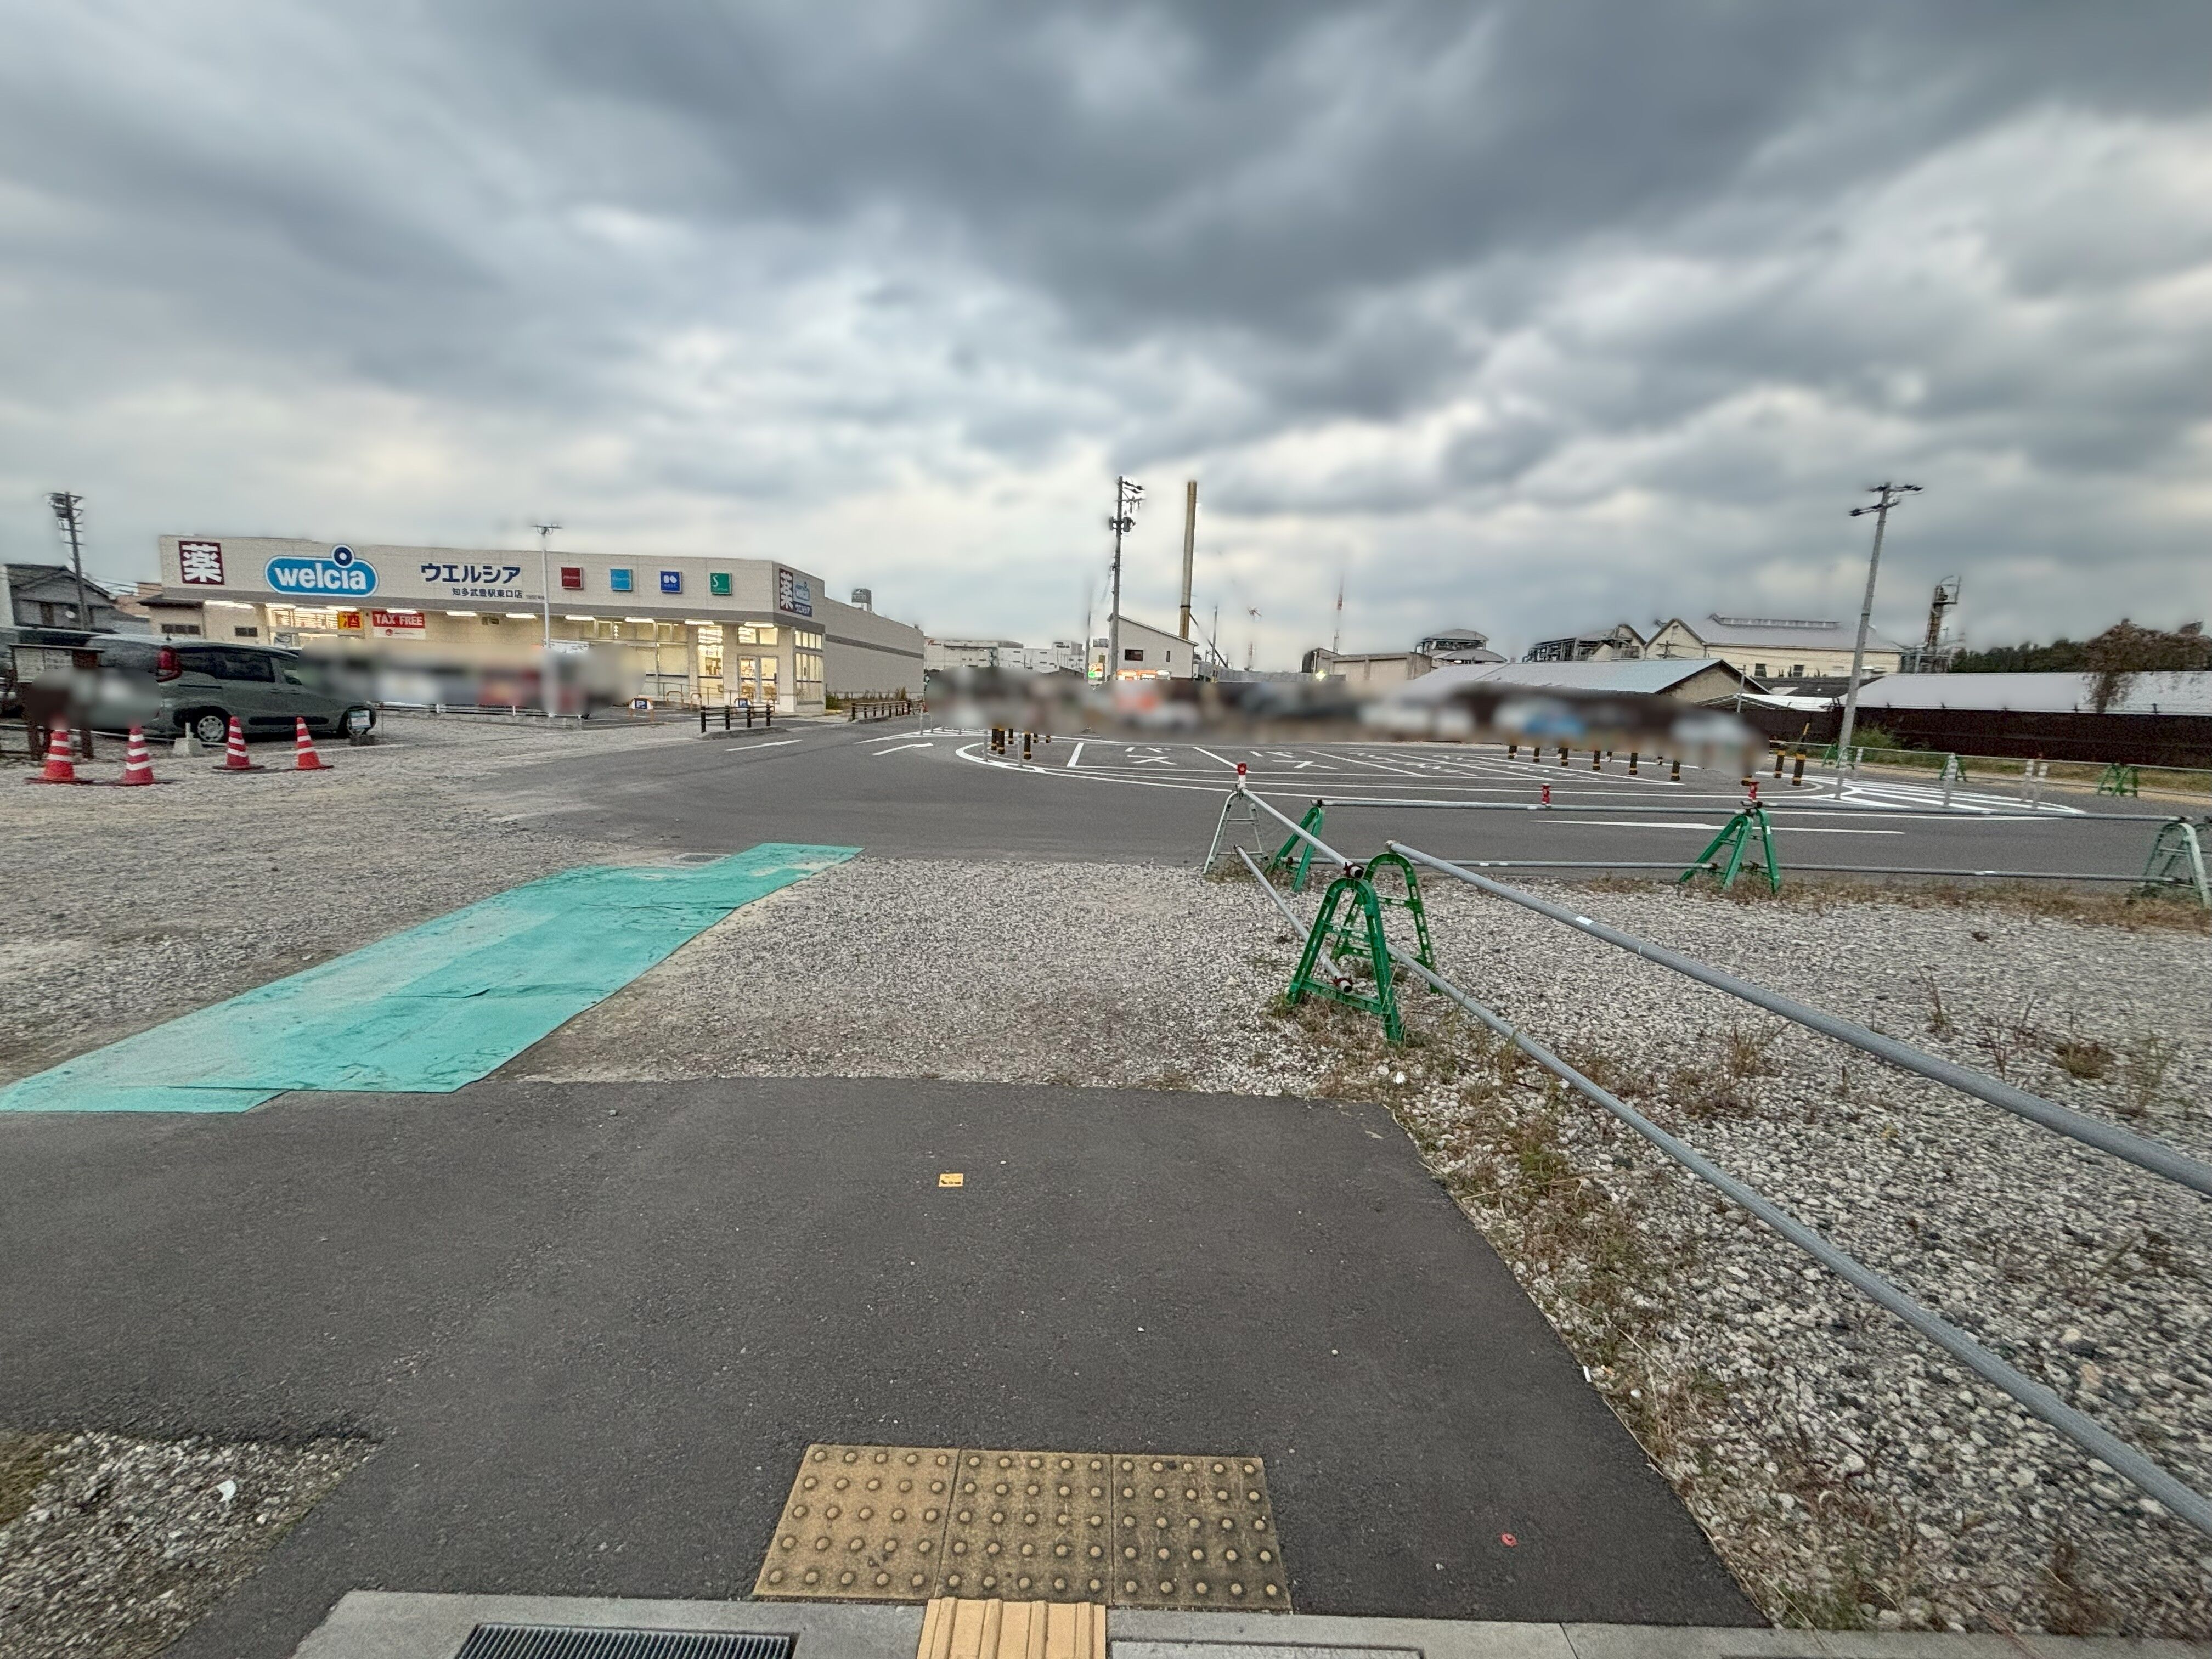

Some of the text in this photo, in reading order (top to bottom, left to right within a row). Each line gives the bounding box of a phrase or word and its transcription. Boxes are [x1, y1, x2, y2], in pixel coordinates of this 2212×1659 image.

[182, 543, 222, 583] 薬
[421, 563, 521, 584] ウエルシア
[274, 562, 367, 590] welcia
[452, 588, 523, 599] 知多武豊駅東口店
[780, 571, 793, 610] 薬
[375, 613, 423, 625] TAX FREE
